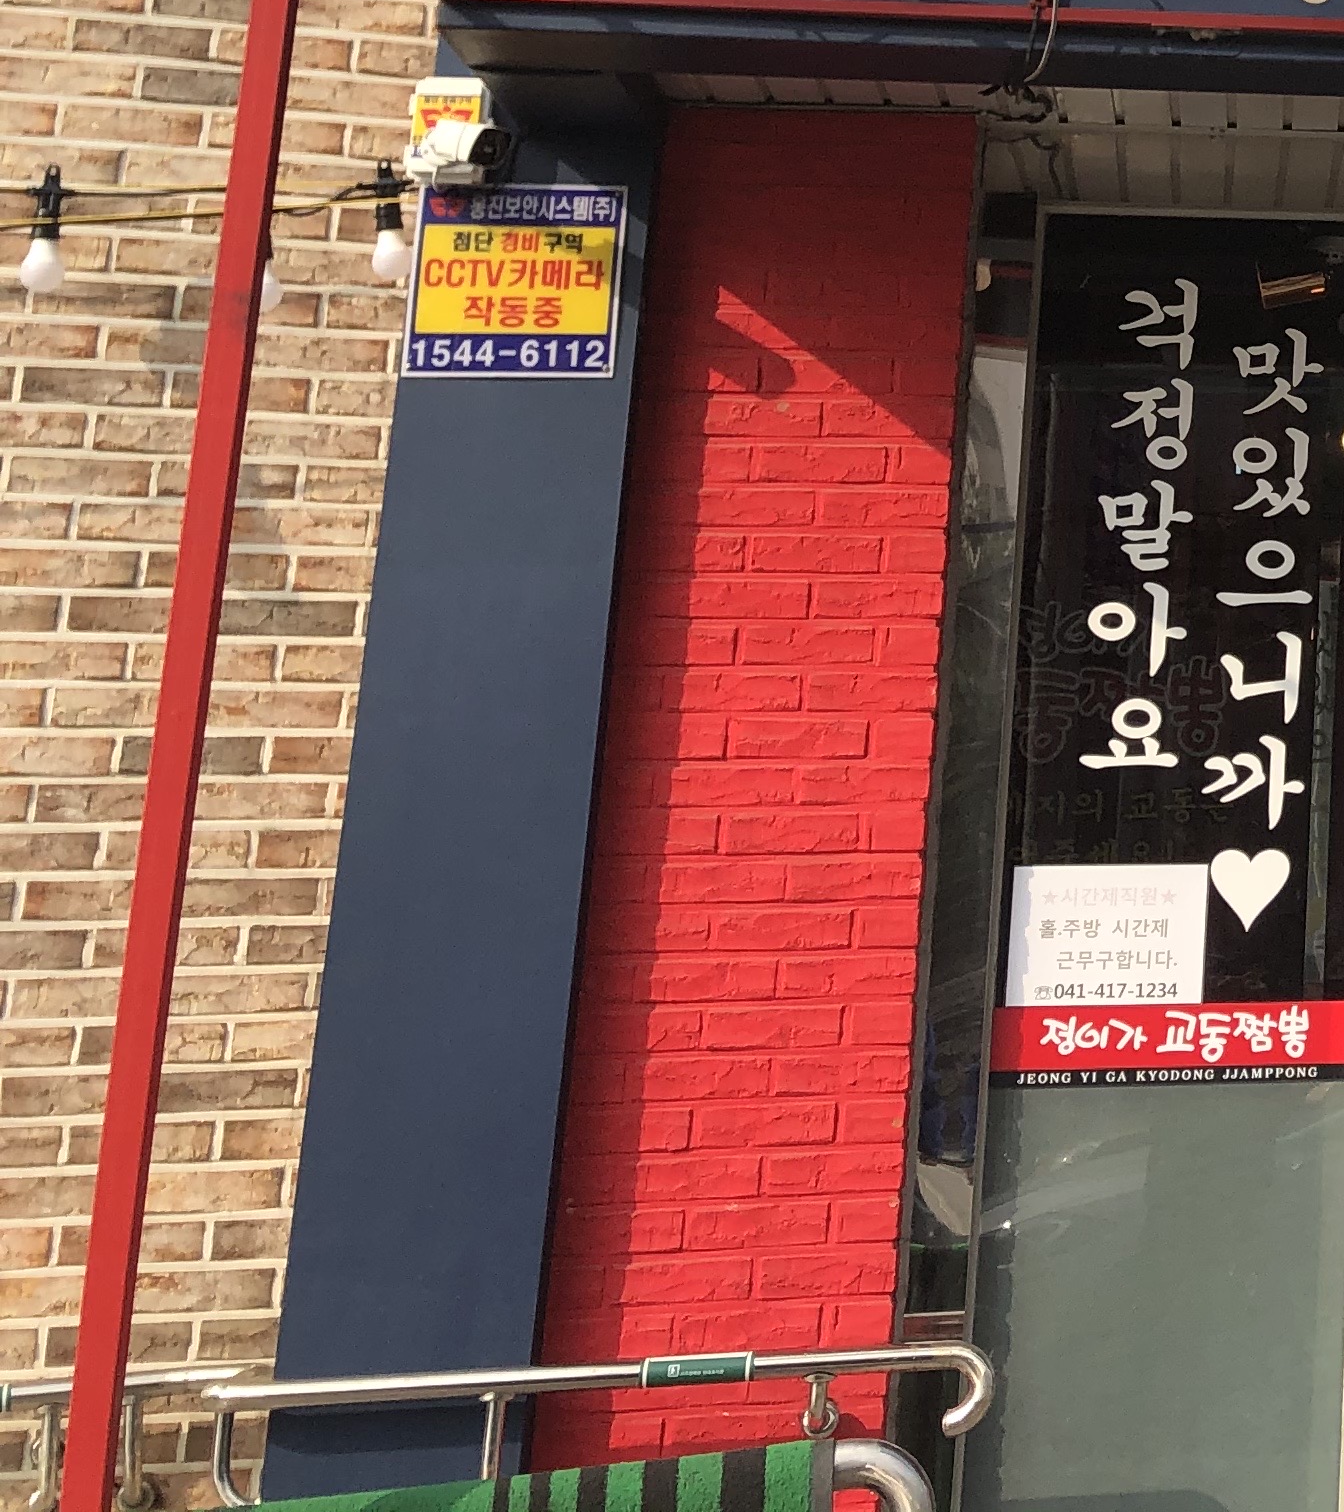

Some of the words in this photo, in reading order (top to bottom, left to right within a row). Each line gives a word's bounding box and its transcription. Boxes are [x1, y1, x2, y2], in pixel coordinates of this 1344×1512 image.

[500, 231, 540, 254] 경비
[544, 231, 584, 256] 구역
[424, 259, 606, 292] CCTV카메라
[463, 295, 564, 329] 작동중
[411, 338, 606, 370] 1544-6112
[1079, 276, 1201, 772] 걱정말아요
[1202, 326, 1325, 832] 맛있으니까
[1039, 918, 1101, 939] 홀.주방
[1111, 918, 1170, 939] 시간제
[1056, 949, 1178, 971] 근무구합니다.
[1054, 982, 1179, 1000] 041-417-1234
[1039, 1016, 1149, 1056] 정이가
[1155, 1005, 1311, 1063] 교동짬뽕
[1016, 1072, 1072, 1086] JEONG
[1080, 1072, 1098, 1085] YI
[1105, 1070, 1127, 1084] GA
[1135, 1068, 1215, 1083] KYODONG
[1221, 1066, 1320, 1081] JJAMPPONG
